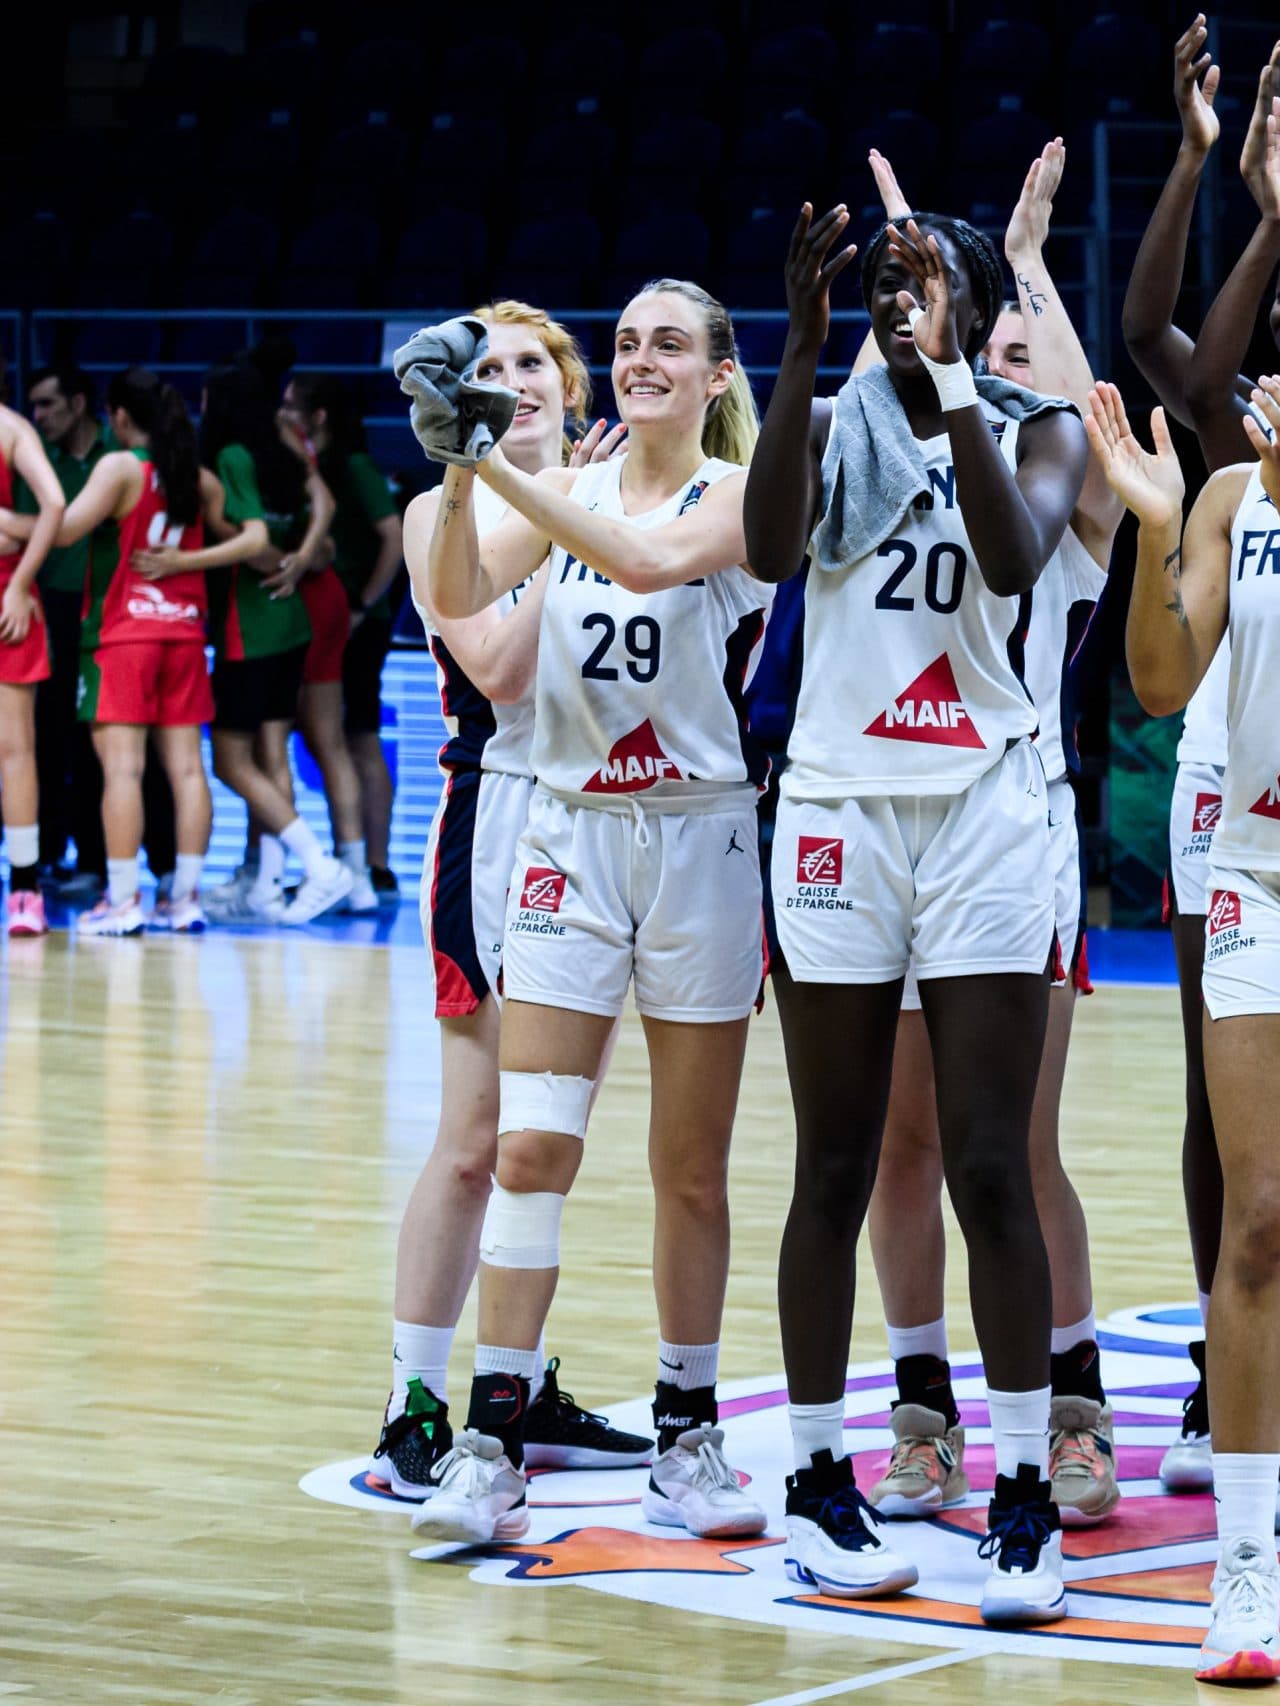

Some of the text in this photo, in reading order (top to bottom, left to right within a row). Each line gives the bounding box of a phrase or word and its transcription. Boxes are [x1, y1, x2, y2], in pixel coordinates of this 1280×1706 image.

[875, 539, 968, 614] 20
[581, 612, 661, 683] 29
[885, 699, 967, 728] MAIF
[600, 755, 673, 784] MAIF
[798, 886, 838, 898] CAISSE
[786, 898, 854, 911] D'EPARGNE
[518, 911, 553, 924] CAISSE
[1210, 928, 1241, 948] CAISSE
